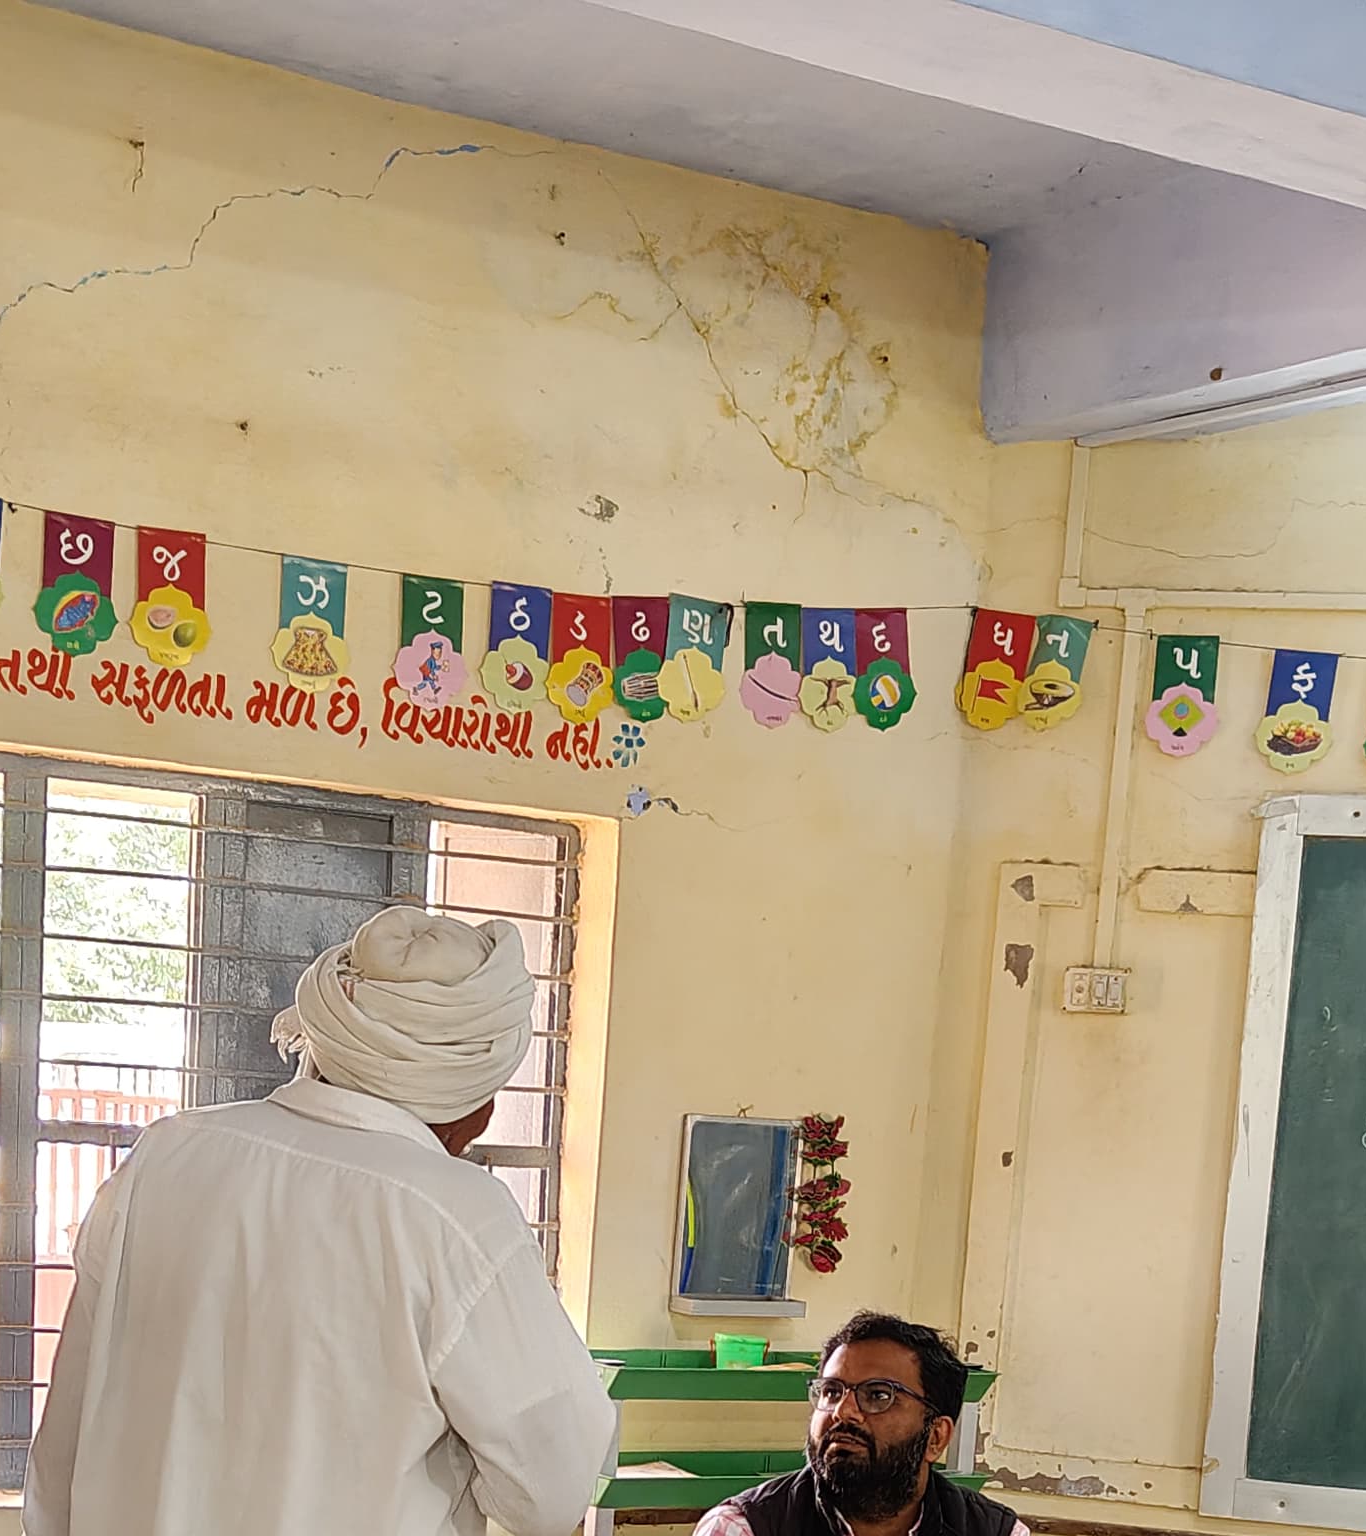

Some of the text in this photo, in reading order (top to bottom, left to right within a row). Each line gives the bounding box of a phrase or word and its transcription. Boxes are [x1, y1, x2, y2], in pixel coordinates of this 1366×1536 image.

[59, 528, 94, 565] છ
[152, 546, 187, 582] જ
[296, 575, 330, 609] ઝ
[422, 591, 444, 624] ટ
[509, 596, 531, 632] ઠ
[569, 610, 588, 641] ડ
[631, 611, 650, 642] ઢ
[682, 608, 713, 645] ણ
[763, 616, 787, 648] ત
[818, 620, 844, 653] થ
[872, 622, 892, 653] દ
[993, 622, 1014, 657] ધ
[1046, 630, 1069, 658] ન
[1173, 647, 1202, 679] પ
[91, 660, 232, 724] સફળતા
[1291, 662, 1317, 699] ફ
